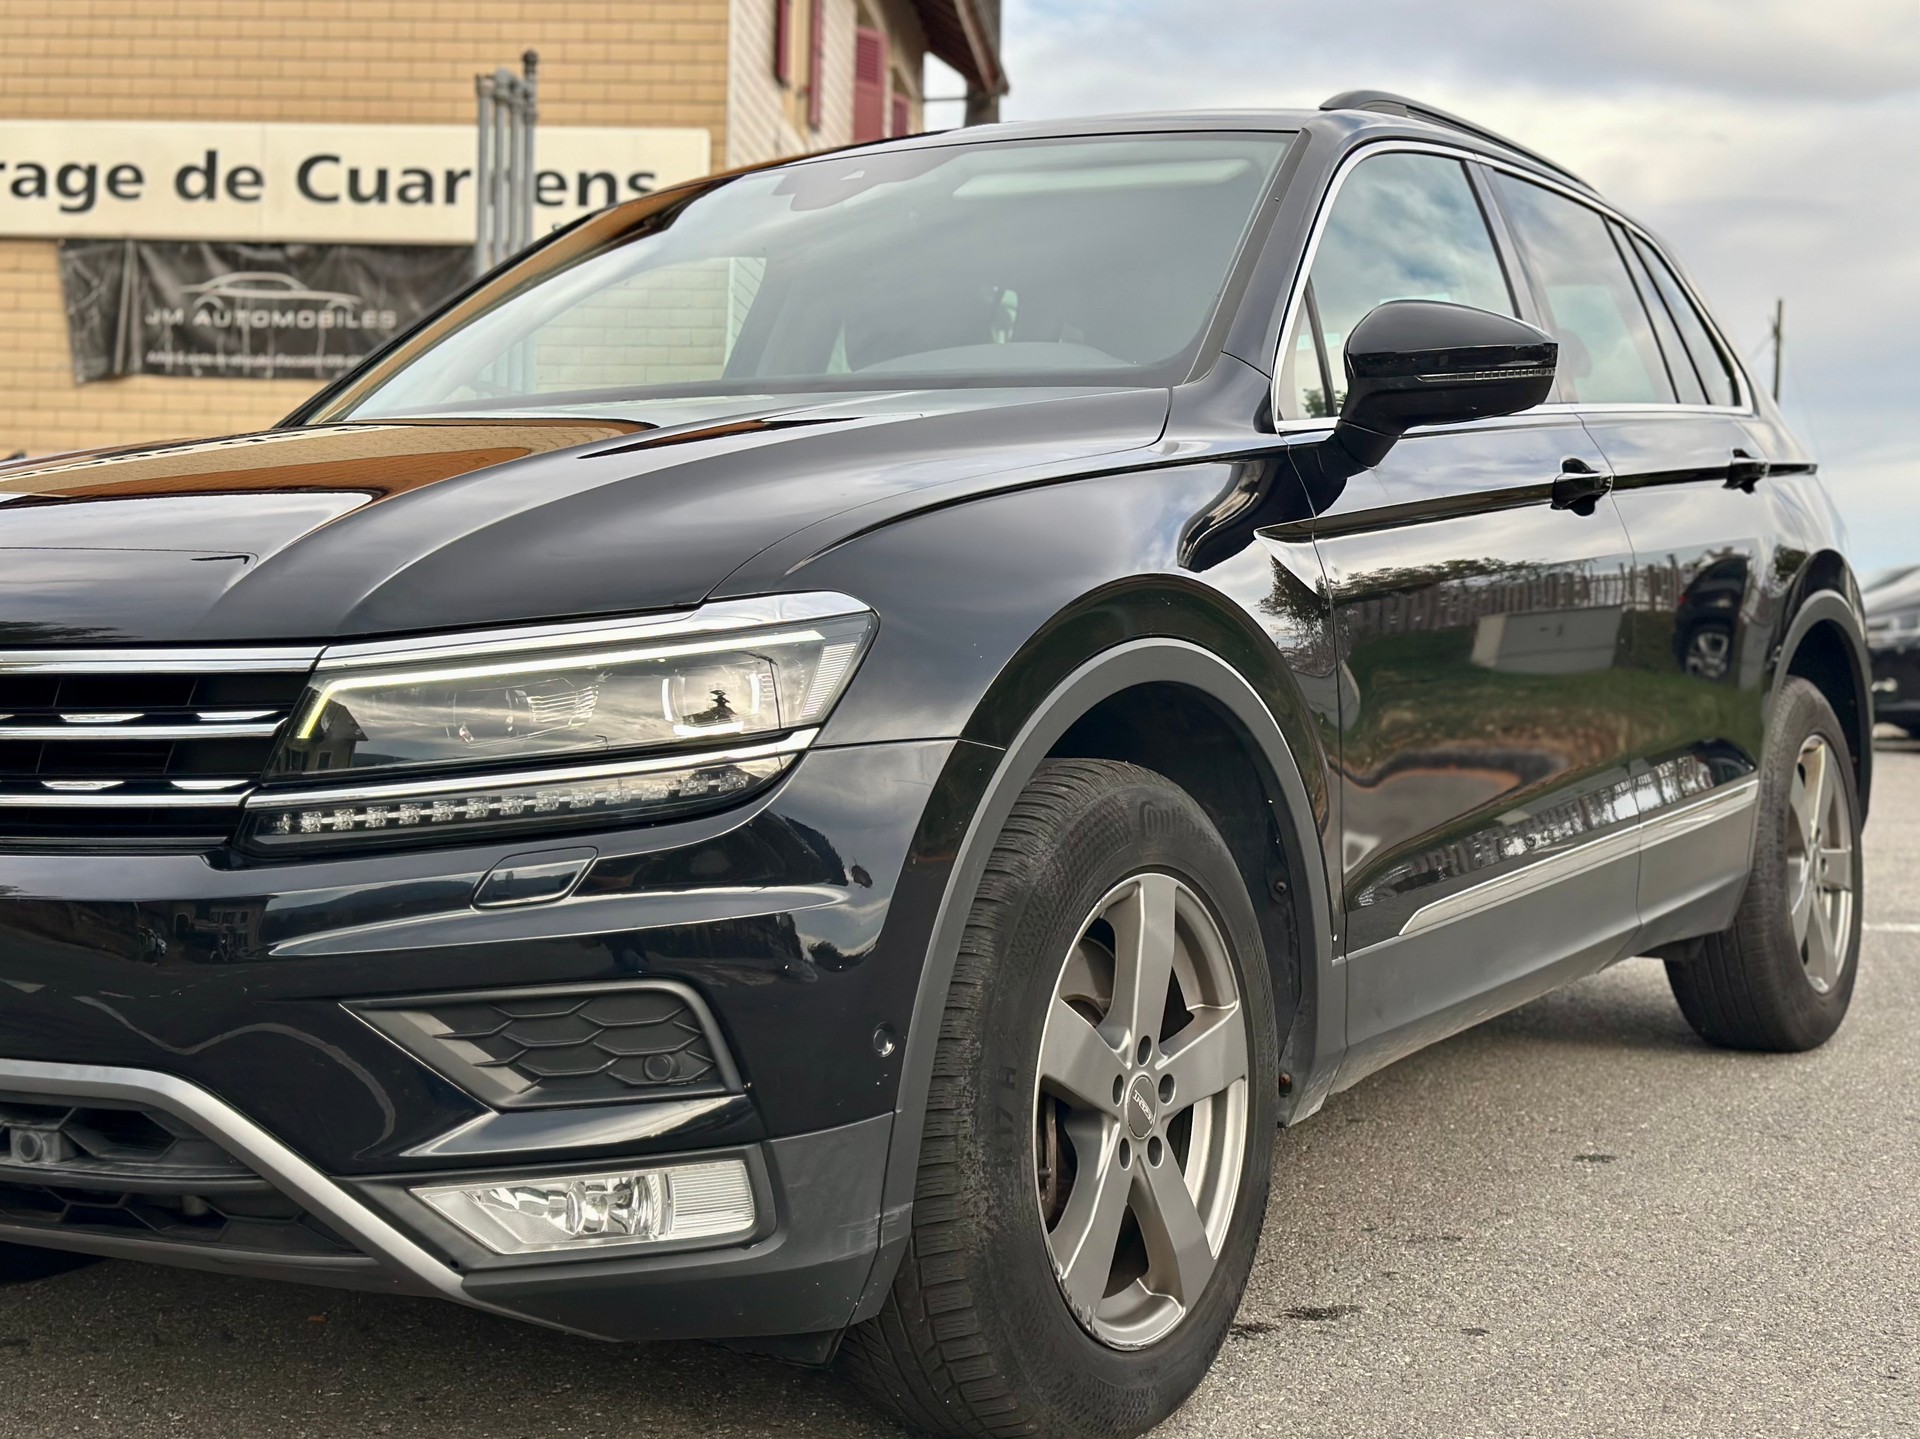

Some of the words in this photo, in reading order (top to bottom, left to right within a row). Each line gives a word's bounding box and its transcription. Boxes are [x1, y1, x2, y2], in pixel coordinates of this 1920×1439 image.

[0, 162, 145, 214] age
[174, 149, 265, 203] de
[296, 154, 657, 207] Cuarens
[144, 307, 185, 326] JM
[192, 308, 398, 329] AUTOMOBILES
